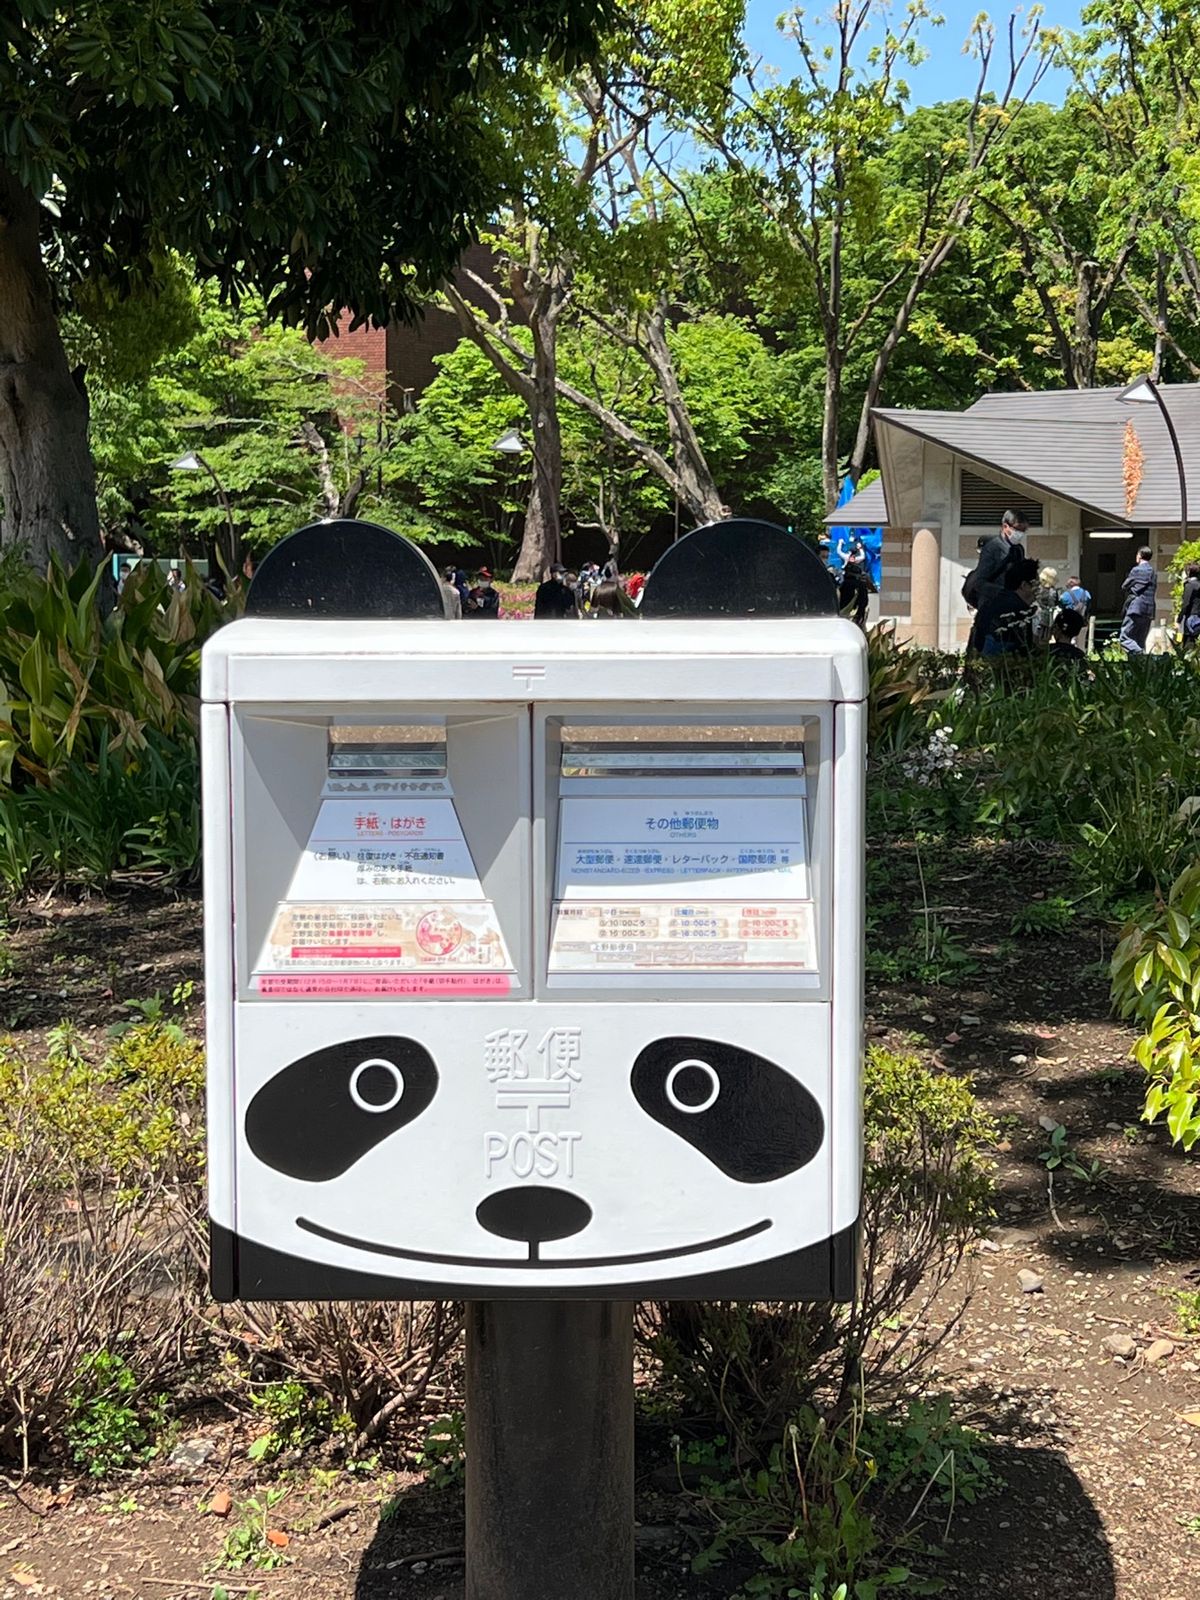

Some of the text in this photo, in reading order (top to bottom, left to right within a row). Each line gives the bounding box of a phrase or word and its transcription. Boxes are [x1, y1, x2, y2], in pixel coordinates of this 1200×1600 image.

[355, 817, 427, 829] 手紙・はがき
[645, 818, 719, 830] その他郵便物
[484, 1028, 581, 1083] 郵便
[484, 1131, 582, 1179] POST
